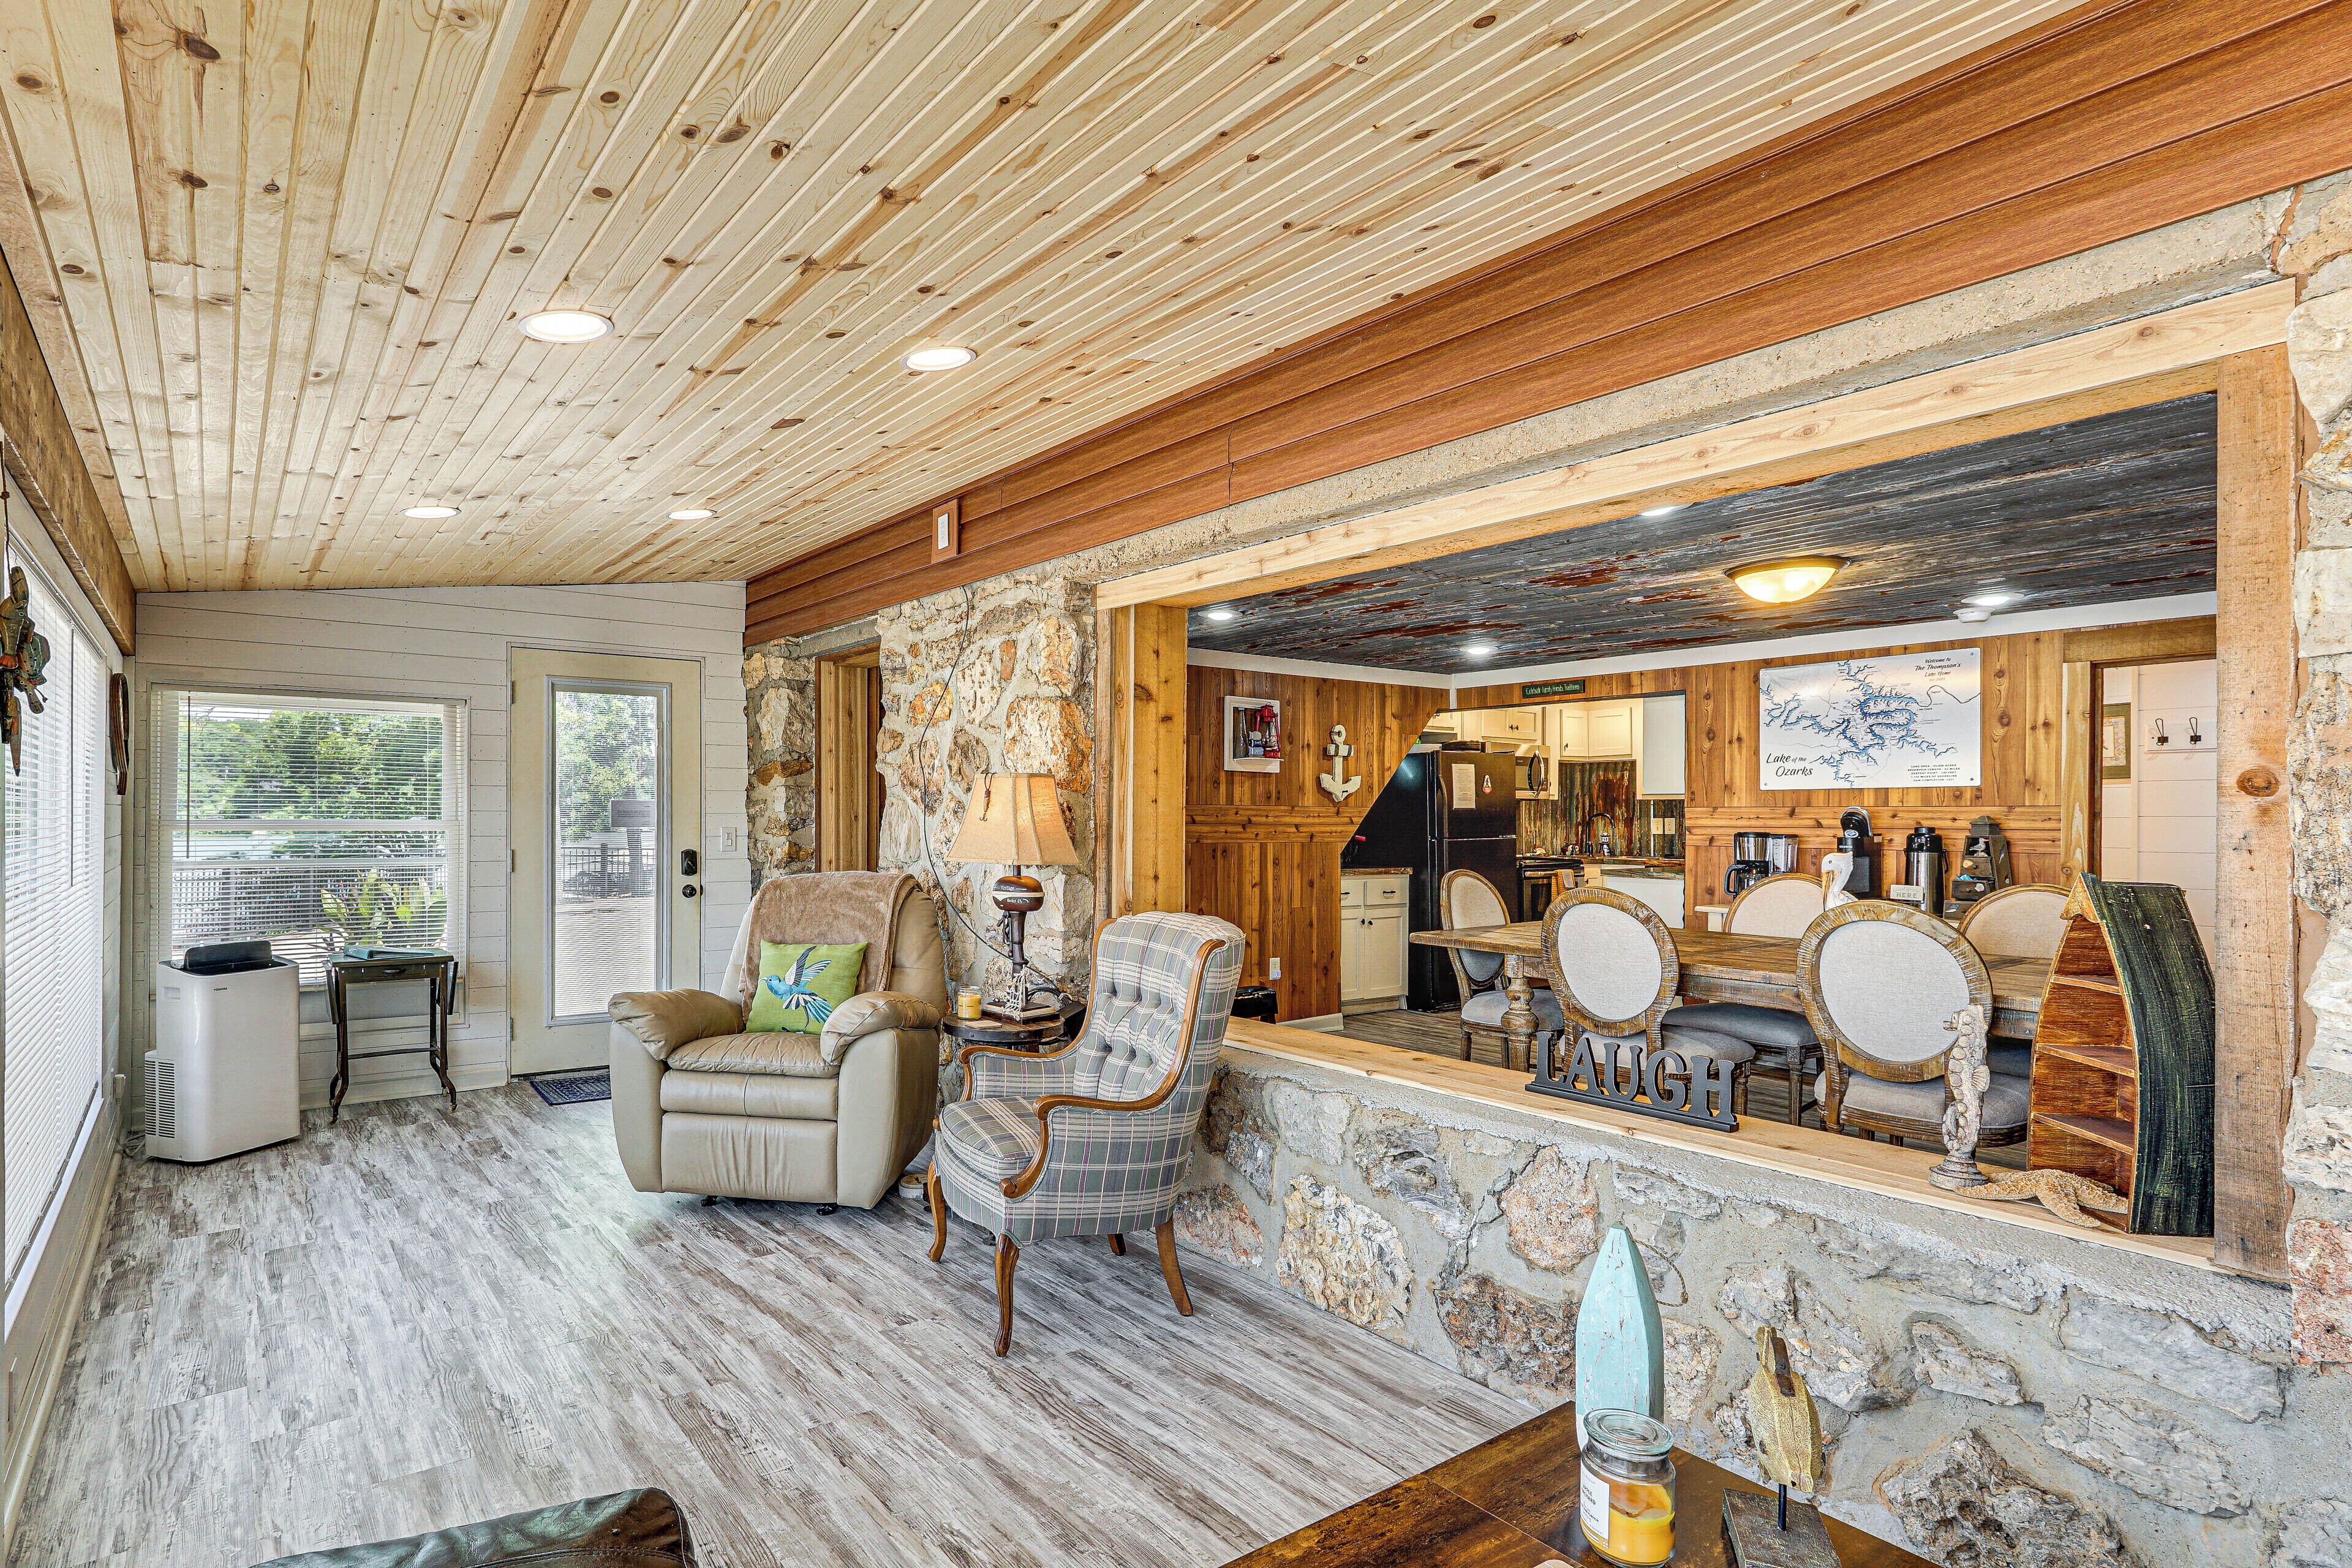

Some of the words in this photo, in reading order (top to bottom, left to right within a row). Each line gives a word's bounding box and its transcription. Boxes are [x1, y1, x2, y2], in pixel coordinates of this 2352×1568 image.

[1766, 753, 1791, 764] Lake
[1776, 766, 1813, 777] Ozarks
[1533, 1031, 1738, 1123] LAUGH
